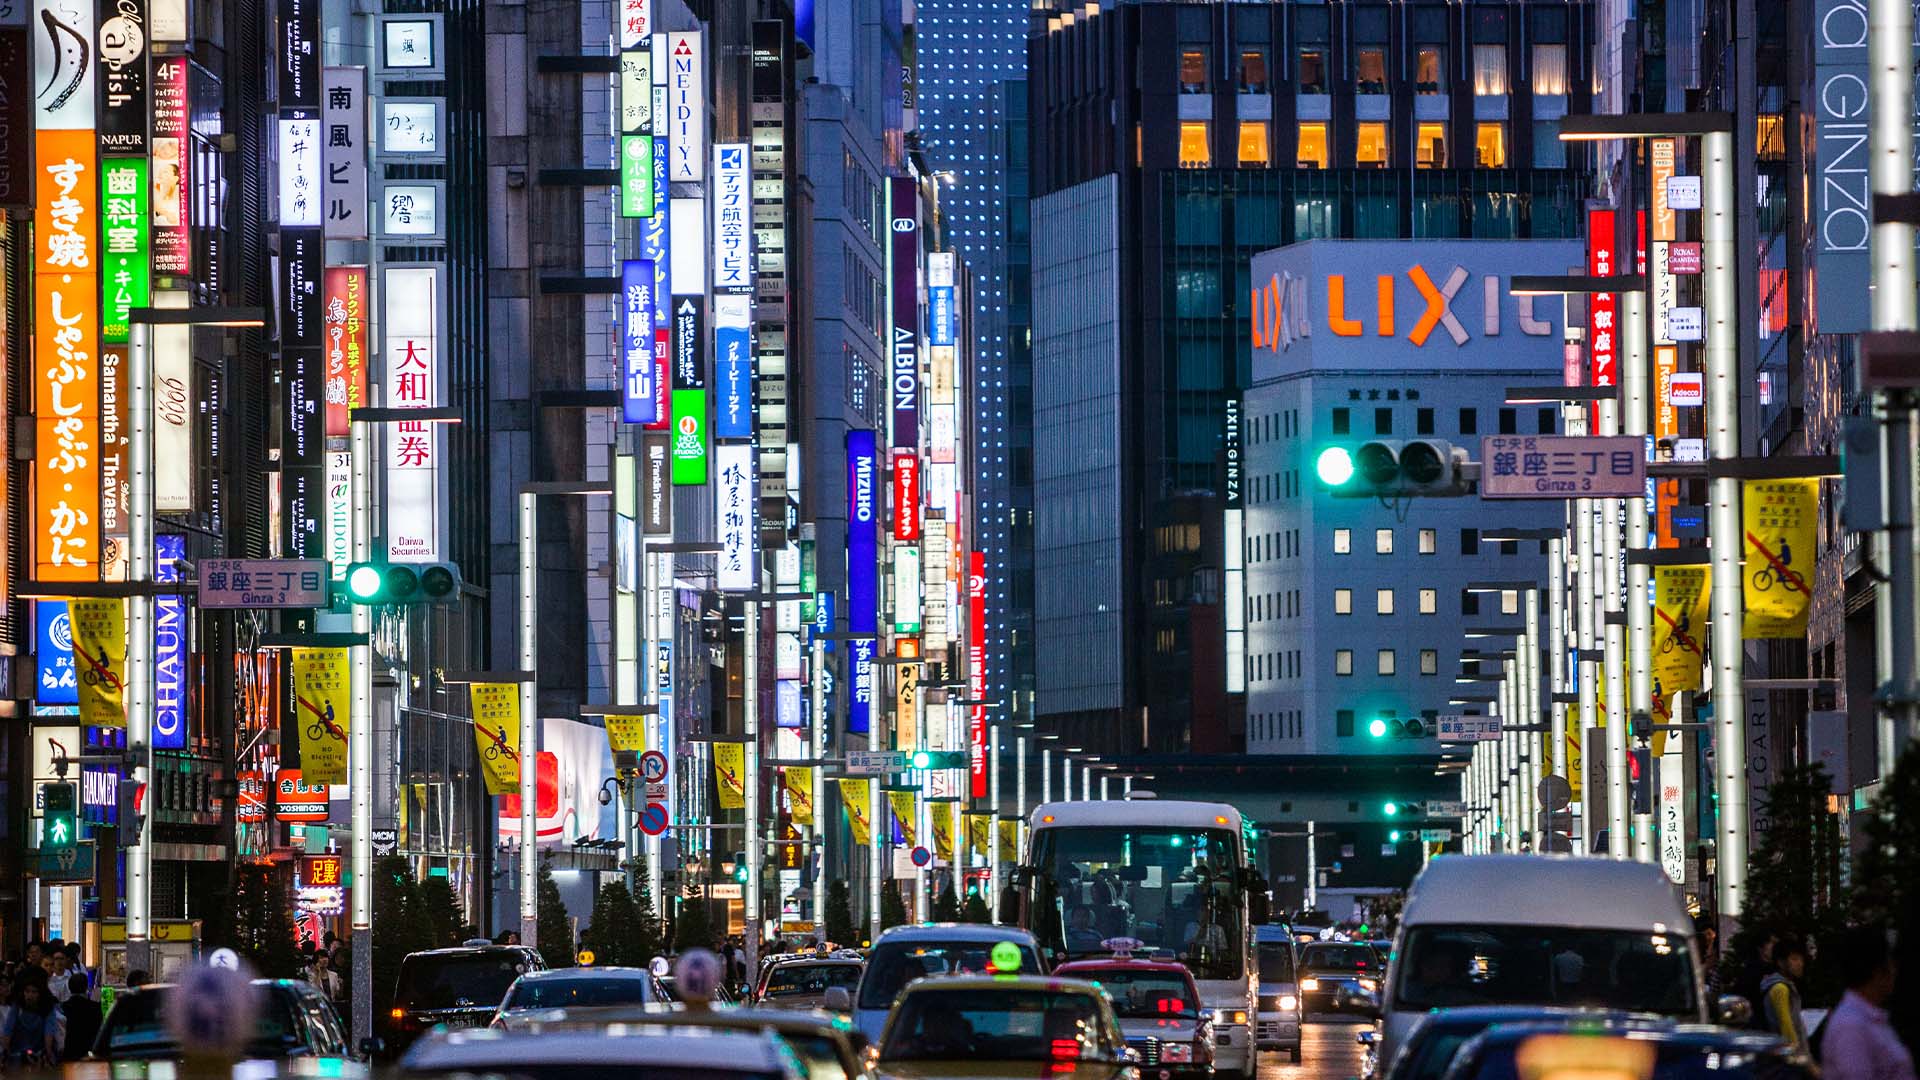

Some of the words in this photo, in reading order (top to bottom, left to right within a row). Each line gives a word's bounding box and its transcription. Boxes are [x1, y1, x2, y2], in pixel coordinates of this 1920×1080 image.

[157, 63, 181, 80] 4F
[101, 134, 142, 145] NAPUR
[328, 86, 352, 220] 南風ビル
[1822, 73, 1869, 250] GINZA
[722, 171, 742, 281] テック航空サービス
[1673, 248, 1695, 256] ROYAL
[1328, 264, 1551, 347] LIXIL
[627, 285, 651, 399] 洋服の青山
[895, 327, 915, 410] ALBION
[103, 353, 119, 443] Samantha
[676, 442, 700, 450] YOGA
[678, 434, 699, 442] HOT
[1492, 438, 1536, 450] 中央区
[1493, 452, 1634, 476] 銀座三丁目
[652, 460, 662, 492] Franklin
[1536, 478, 1576, 491] Ginza
[1582, 478, 1591, 490] 3
[103, 453, 119, 529] Thavasa
[857, 456, 871, 521] MIZUHO
[652, 493, 662, 525] Planner
[399, 537, 424, 546] Daiwa
[391, 547, 429, 556] Securities
[207, 561, 242, 570] 中央区
[207, 572, 320, 591] 銀座三丁目
[241, 593, 273, 604] Ginza
[277, 593, 285, 603] 3
[1442, 722, 1499, 733] 銀座二丁目
[83, 770, 118, 806] HAUMET
[372, 831, 395, 841] MCM
